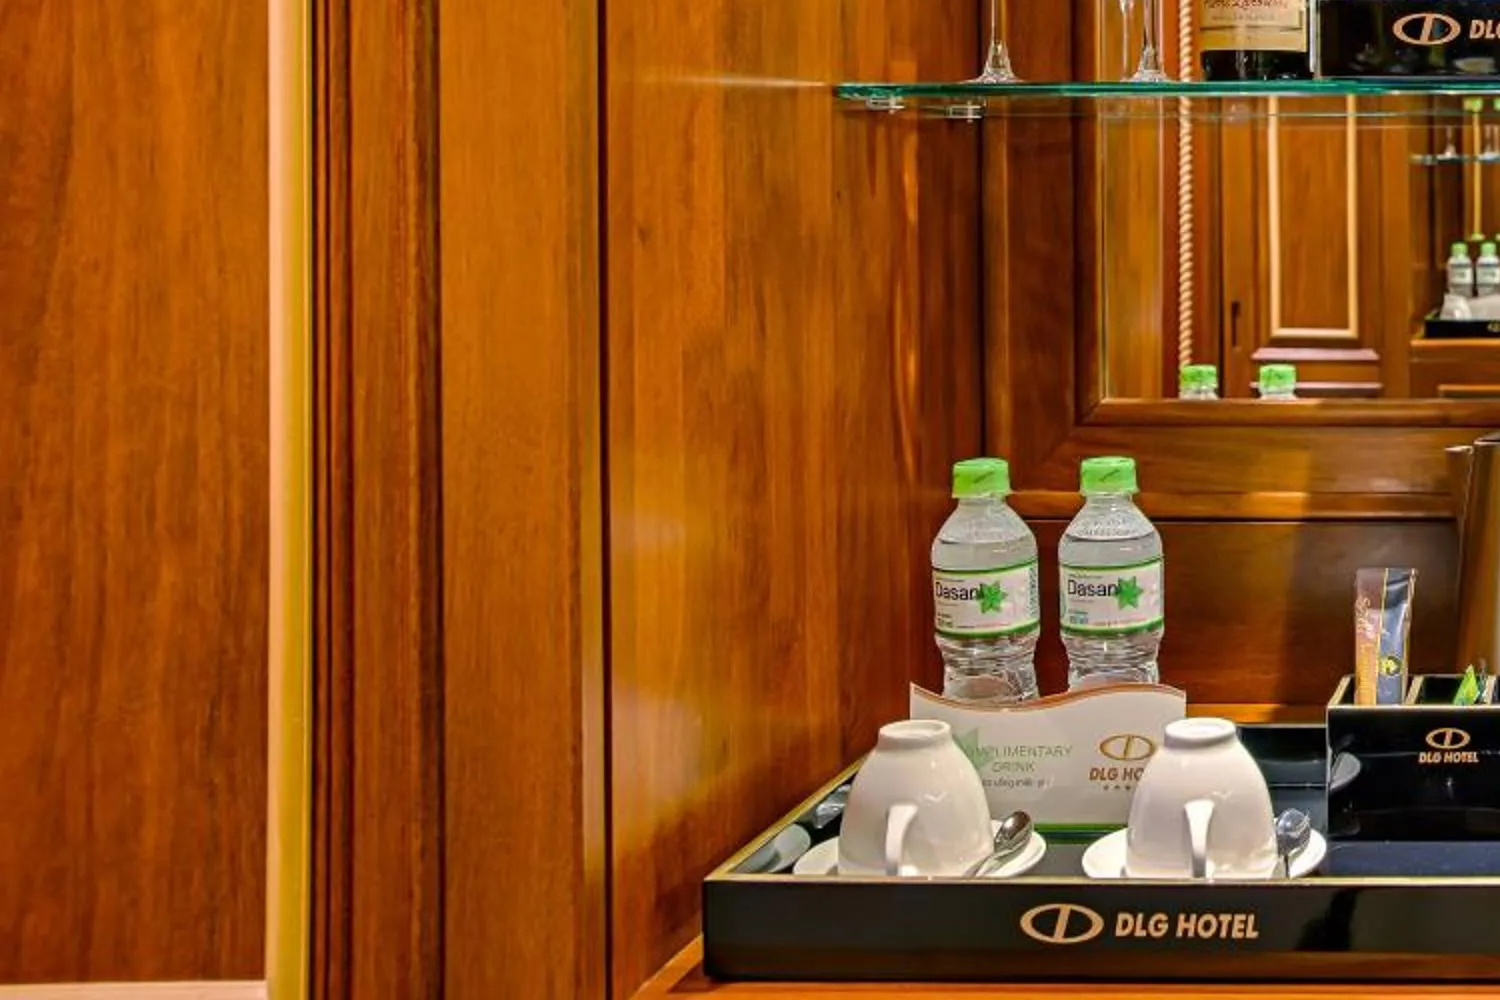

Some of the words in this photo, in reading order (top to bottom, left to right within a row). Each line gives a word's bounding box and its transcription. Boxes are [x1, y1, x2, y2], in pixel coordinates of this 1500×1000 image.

[1443, 750, 1479, 764] HOTEL
[1089, 767, 1119, 781] DLG
[1115, 912, 1169, 938] DLG
[1175, 912, 1260, 939] HOTEL
